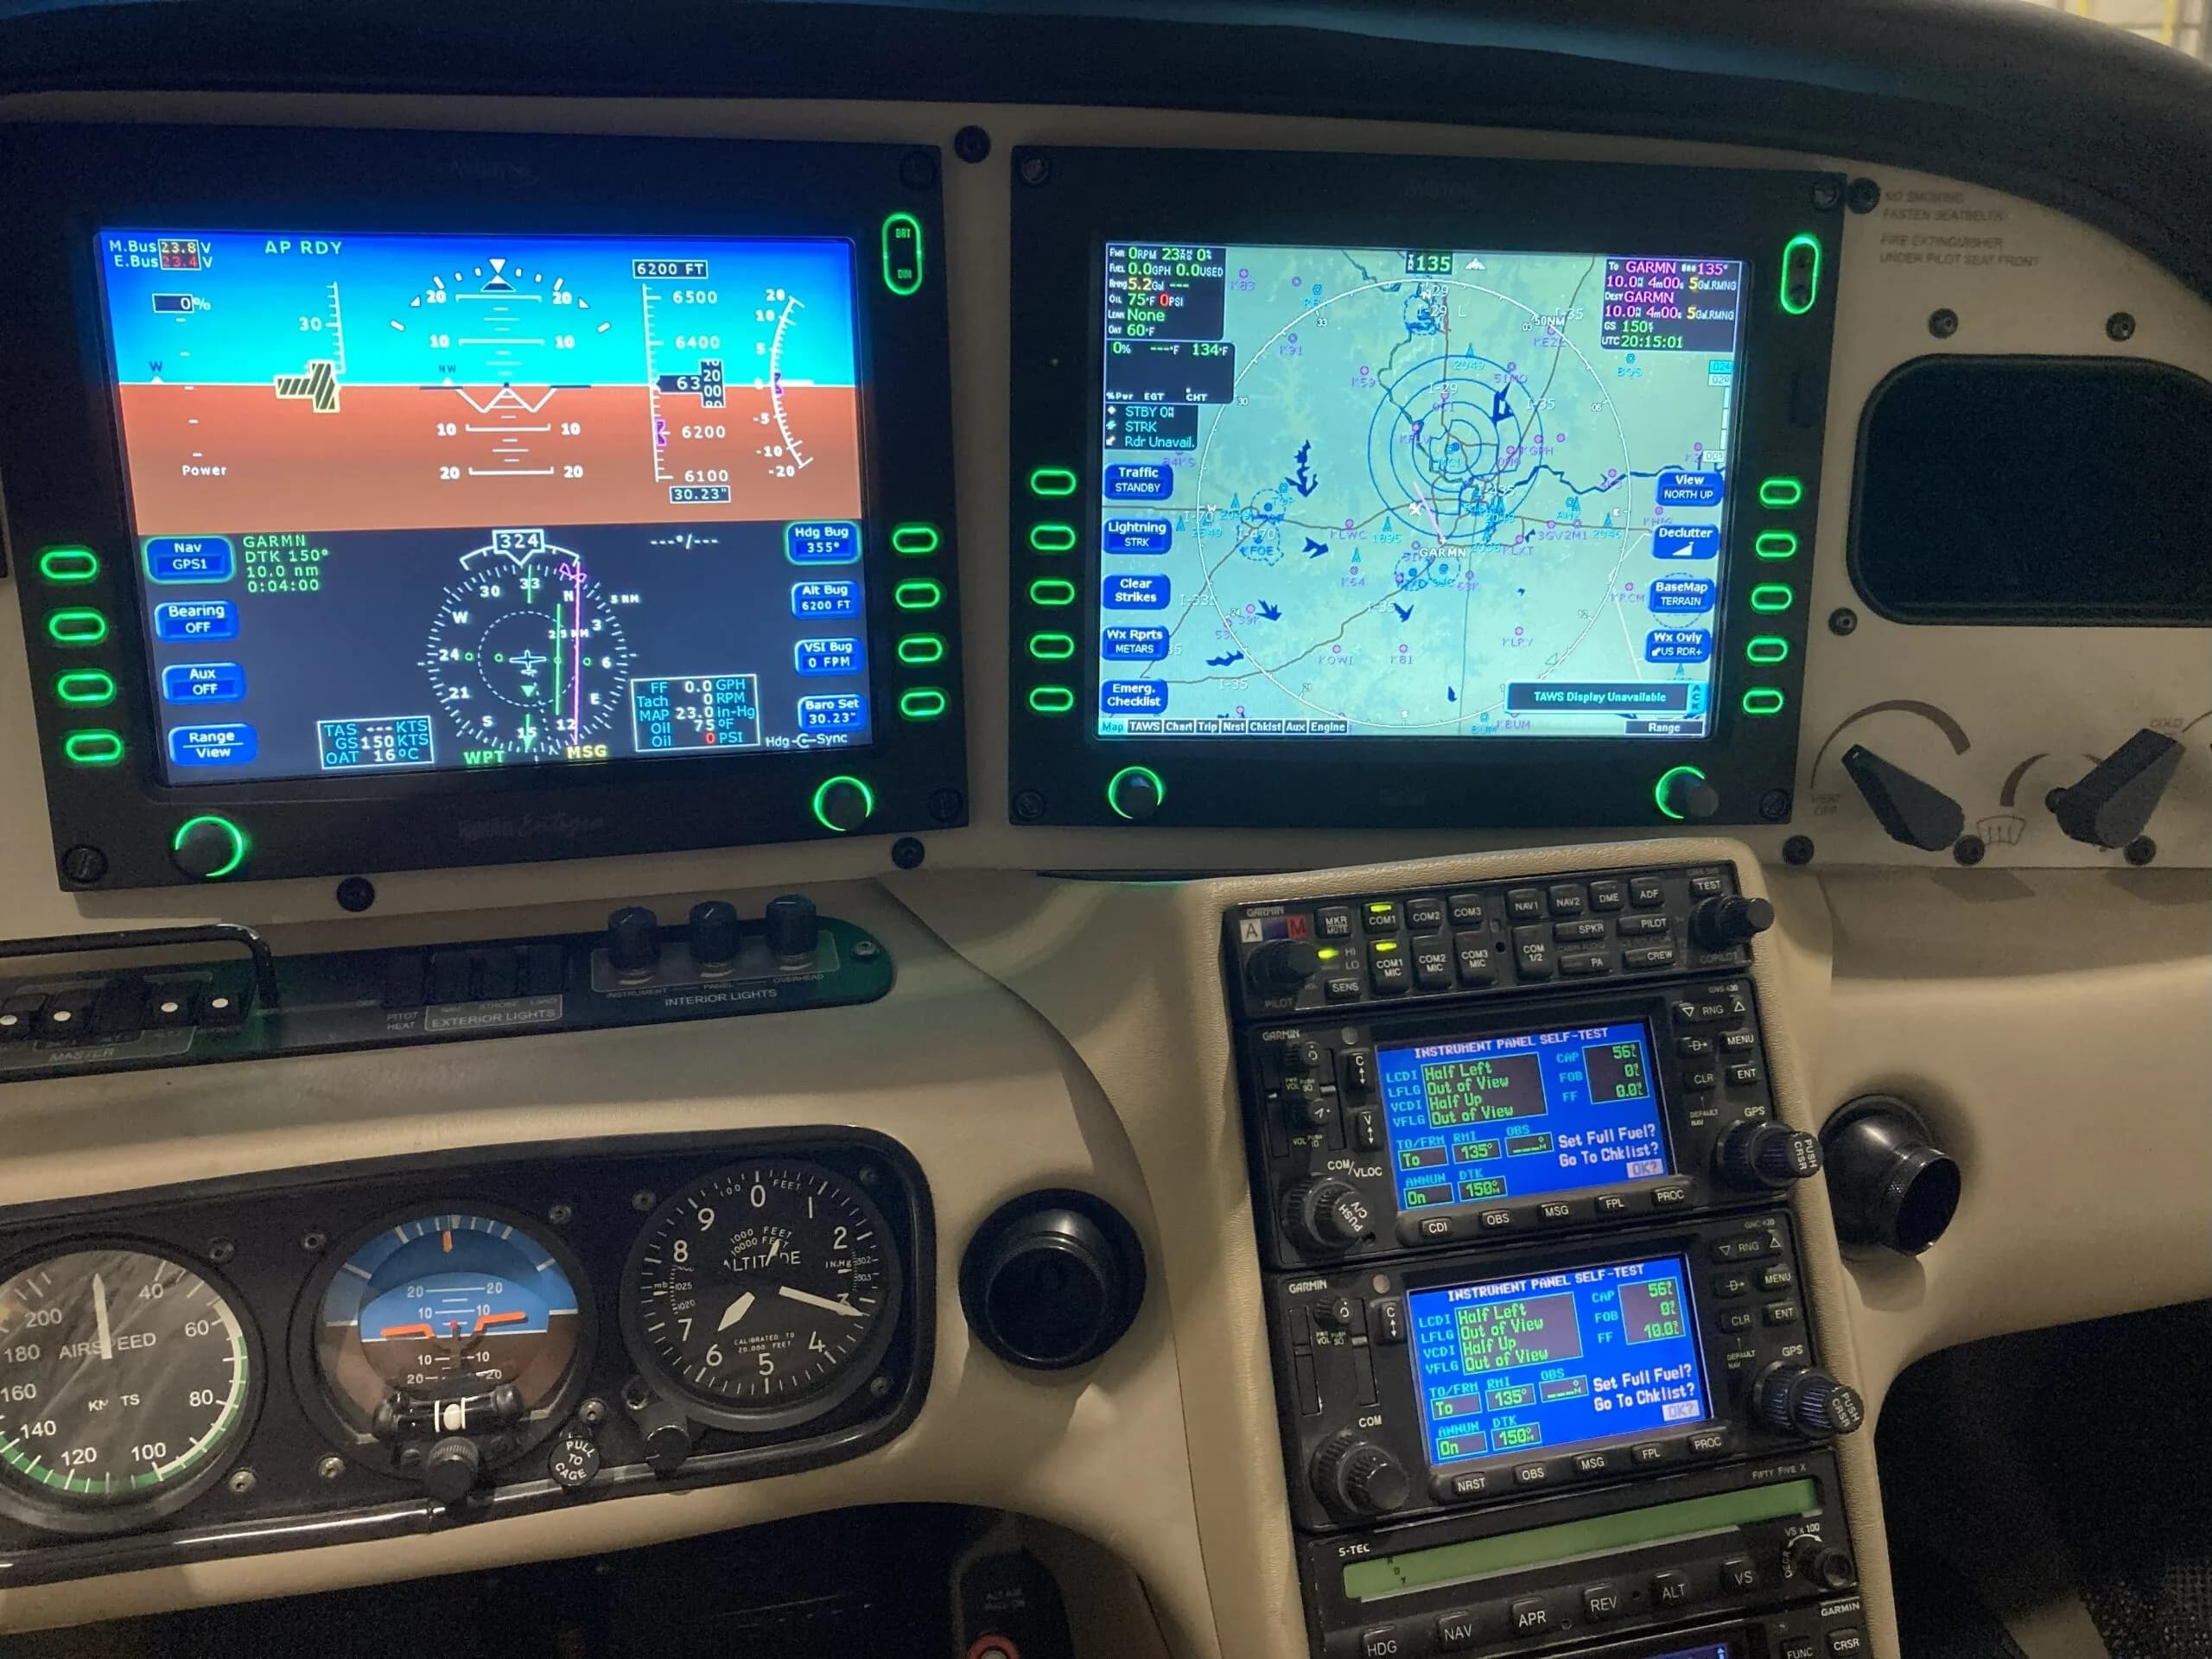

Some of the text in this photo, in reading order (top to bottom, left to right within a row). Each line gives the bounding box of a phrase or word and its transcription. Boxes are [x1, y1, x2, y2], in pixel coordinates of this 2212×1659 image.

[110, 241, 211, 254] M.Bus 23.8 V
[265, 241, 342, 255] AP RDY
[637, 262, 703, 276] 6200 FT
[1626, 261, 1675, 274] GARMN
[1624, 292, 1674, 303] GARMN
[1128, 310, 1165, 321] None
[1621, 336, 1683, 347] 20:15:01
[1125, 406, 1156, 417] STBY
[1125, 422, 1157, 432] STRK
[1125, 436, 1194, 448] Rdr Unavail.
[182, 465, 226, 476] Power
[1118, 467, 1159, 479] Traffic
[1675, 475, 1704, 486] View
[1116, 482, 1160, 493] STANDBY
[1664, 490, 1713, 499] NORTH UP
[795, 526, 849, 539] Hdg Bug
[1109, 522, 1166, 535] Lightning
[1659, 528, 1713, 538] Declutter
[244, 535, 305, 548] GARMN
[500, 535, 539, 548] 324
[1125, 537, 1148, 547] STRK
[175, 543, 201, 553] Nav
[245, 549, 328, 563] DTK 150°
[173, 559, 207, 570] GPS1
[247, 566, 319, 578] 10.0 nm
[248, 579, 319, 593] 0:04:00
[1120, 578, 1151, 588] Clear
[1656, 582, 1707, 594] BaseMap
[803, 585, 848, 597] Alt Bug
[1116, 592, 1156, 602] Strikes
[803, 600, 851, 610] 6200 FT
[1661, 597, 1701, 606] TERRAIN
[168, 605, 225, 619] Bearing
[186, 622, 210, 633] OFF
[1107, 630, 1162, 641] Wx Rprts
[1654, 632, 1701, 645] Wx Ovly
[1116, 645, 1154, 654] METARS
[190, 668, 215, 679] Aux
[193, 683, 217, 695] OFF
[652, 679, 746, 692] FF 0.0 GPH
[1113, 683, 1155, 695] Emerg.
[1107, 696, 1161, 708] Checklist
[1535, 692, 1666, 703] TAWS Display Unavailable
[639, 706, 754, 721] MAP 23.0 in-Hg
[324, 721, 428, 736] TAS KTS
[1103, 722, 1123, 733] Map
[1130, 721, 1160, 732] TAWS
[1166, 721, 1192, 732] Chart
[1198, 721, 1217, 734] Trip
[1223, 721, 1244, 732] Nrst
[1287, 721, 1306, 732] Aux
[1311, 721, 1345, 734] Engine
[1649, 722, 1680, 734] Range
[189, 731, 235, 745] Range
[336, 734, 429, 749] GS 150 KTS
[766, 736, 790, 748] Hdg
[817, 734, 847, 747] Sync
[196, 747, 231, 758] View
[464, 751, 505, 764] WPT
[568, 745, 607, 758] MSG
[1698, 880, 1720, 891] TEST
[1599, 893, 1619, 903] DME
[1640, 889, 1659, 899] ADF
[1516, 901, 1539, 912] NAV1
[1556, 897, 1580, 907] NAV2
[1413, 911, 1440, 922] COM2
[1454, 907, 1481, 918] COM3
[1369, 915, 1395, 926] COM1
[1579, 925, 1604, 935] SPKR
[664, 988, 777, 1007] INTERIOR LIGHTS
[432, 1009, 555, 1028] EXTERIOR LIGHTS
[1657, 1190, 1684, 1203] PROC
[1606, 1198, 1624, 1209] FPL
[1546, 1205, 1568, 1217] MSG
[1487, 1213, 1510, 1225] OBS
[1429, 1222, 1447, 1234] CDI
[1448, 1264, 1644, 1303] INSTRUMENT PANEL SELF-TEST
[1764, 1272, 1790, 1285] MENU
[1288, 1280, 1326, 1294] GARMIN
[1419, 1303, 1526, 1327] LCDI Half Left
[1776, 1307, 1793, 1320] ENT
[184, 1319, 208, 1336] 60
[1421, 1316, 1543, 1343] LFLG Out of View
[1593, 1364, 1692, 1392] Set Full Fuel?
[189, 1389, 213, 1407] 80
[1594, 1383, 1694, 1410] Go To Chklist?
[131, 1443, 167, 1462] 100
[566, 1440, 594, 1459] PULL
[61, 1447, 97, 1466] 120
[569, 1453, 582, 1465] TO
[556, 1462, 587, 1480] CAGE
[1458, 1478, 1484, 1491] NRST
[1662, 1583, 1686, 1599] ALT
[1590, 1596, 1618, 1611] REV
[1821, 1601, 1859, 1617] GARMIN
[1518, 1611, 1547, 1627] APR
[1444, 1624, 1472, 1641] NAV
[1367, 1640, 1397, 1656] HDG
